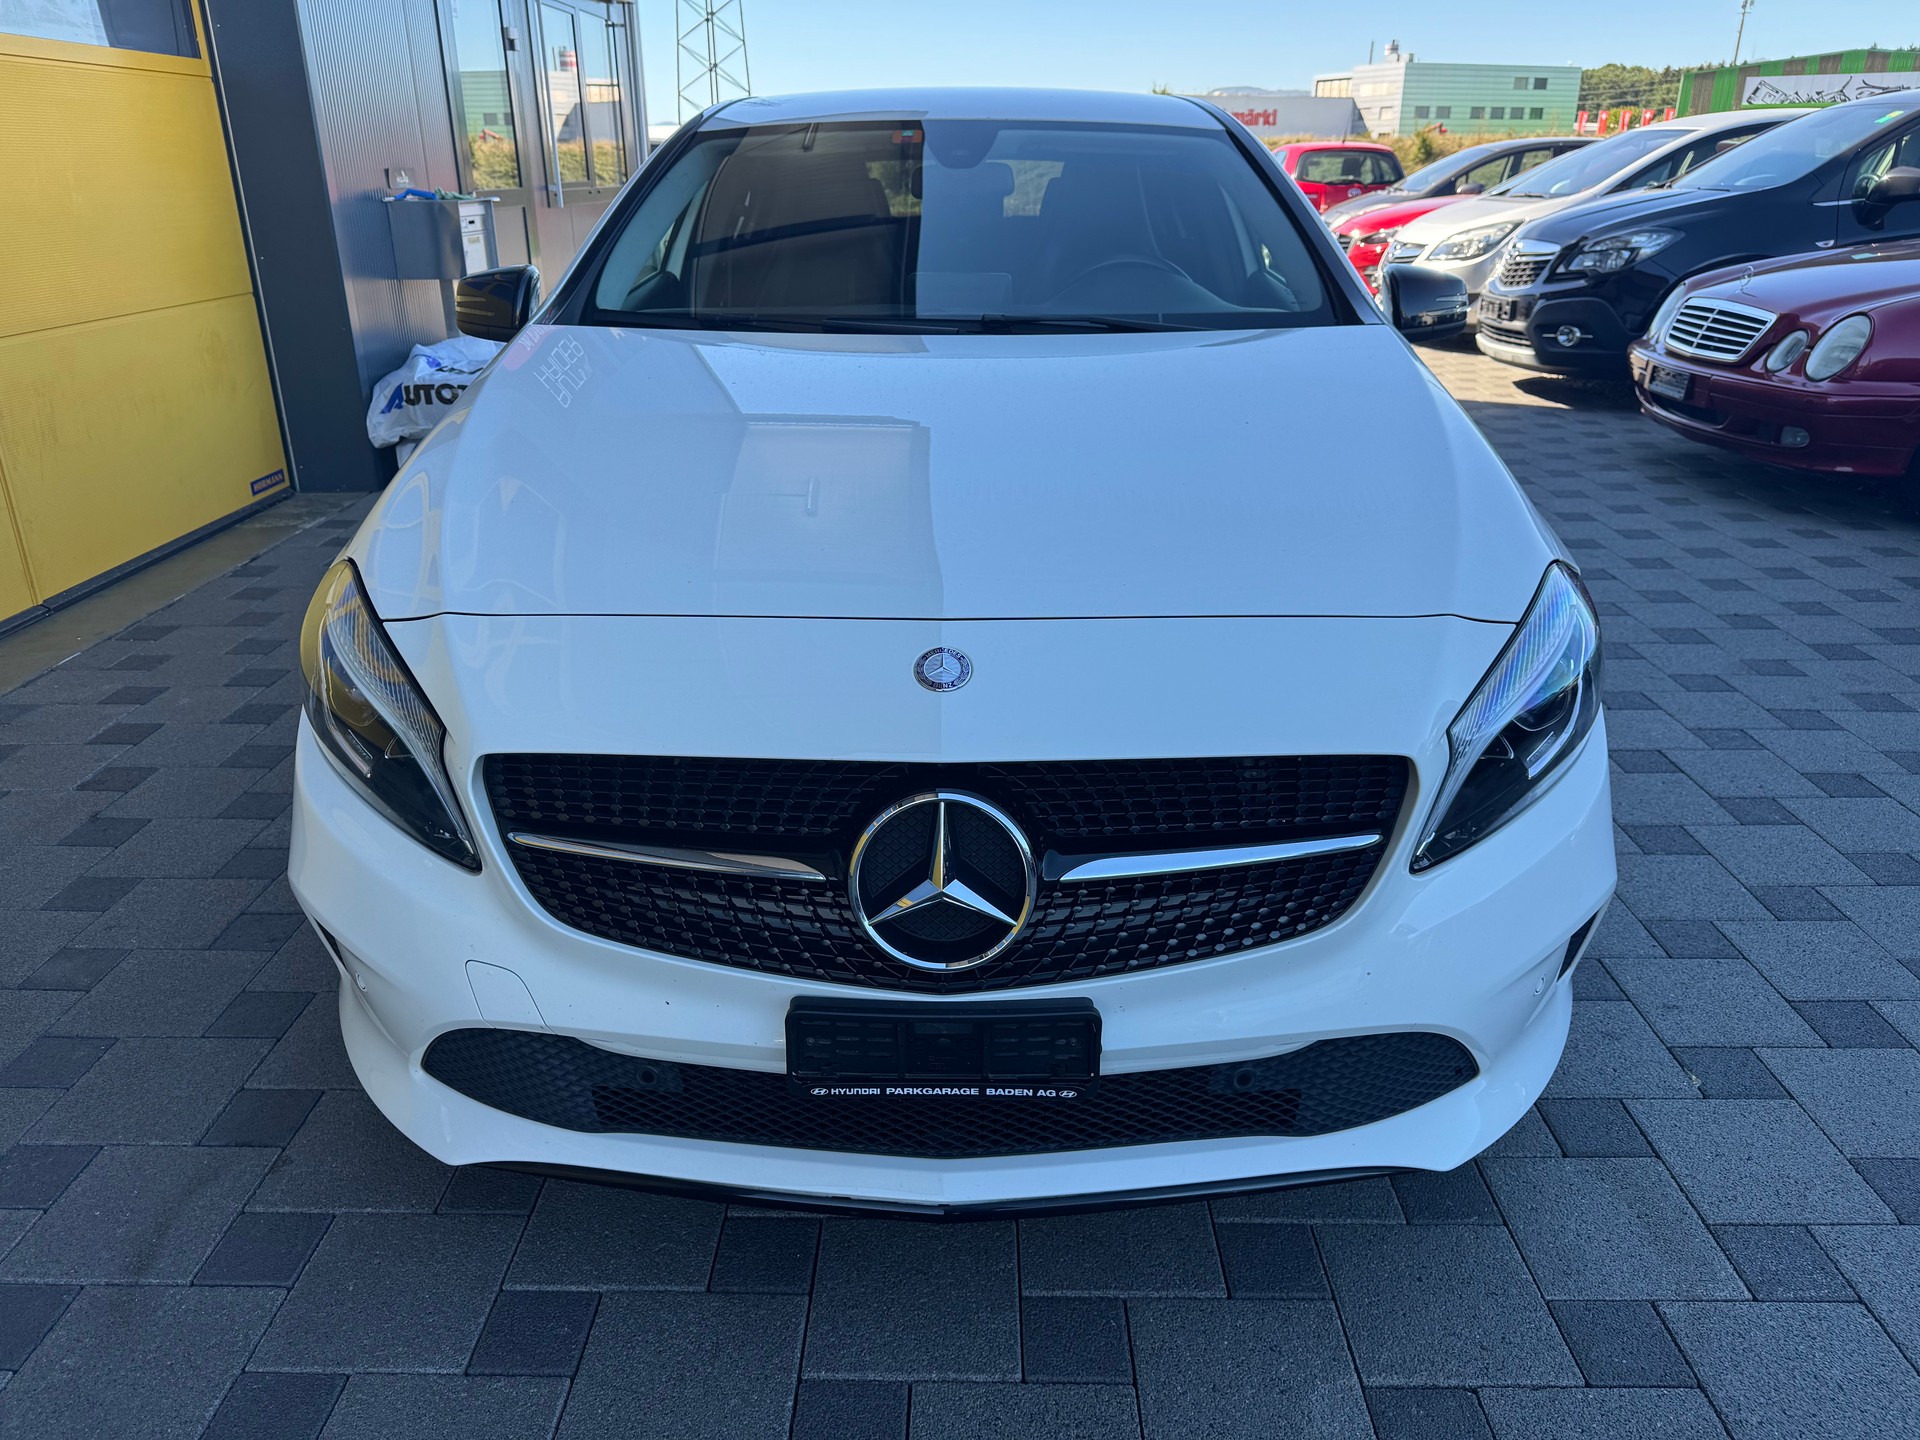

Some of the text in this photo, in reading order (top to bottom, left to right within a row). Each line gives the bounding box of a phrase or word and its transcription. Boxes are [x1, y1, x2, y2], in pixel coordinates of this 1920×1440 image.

[830, 1087, 1057, 1097] HYUNDAI PARKGARAGE BADEN AG
